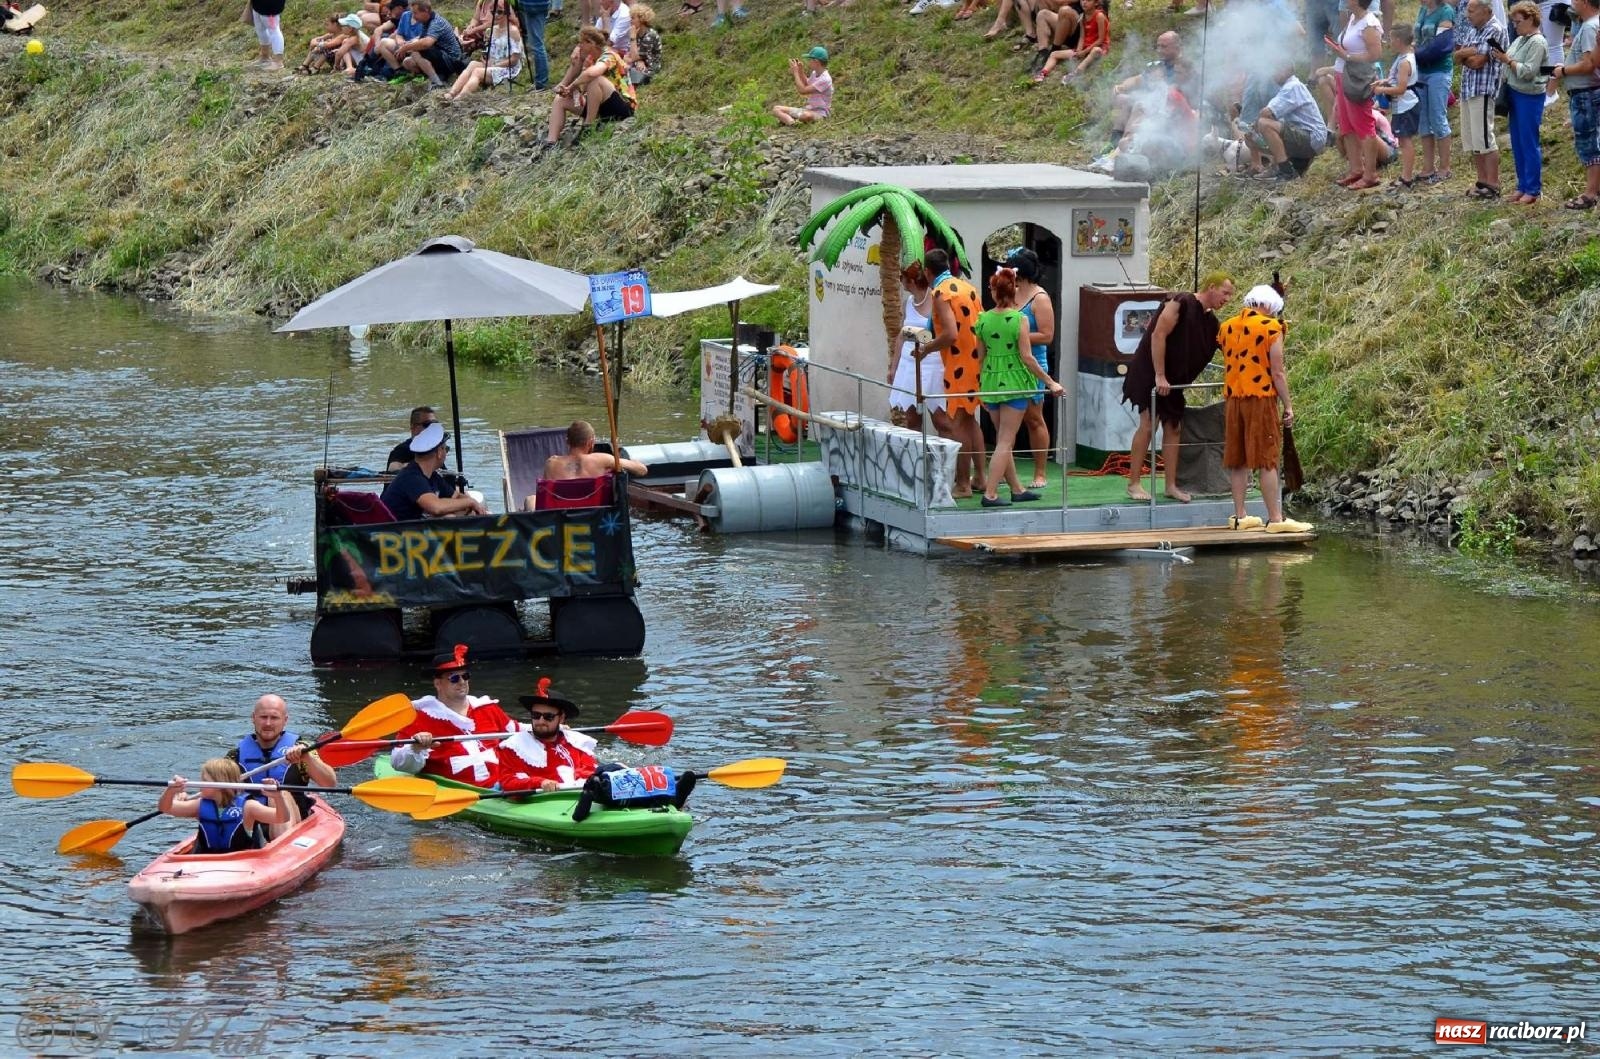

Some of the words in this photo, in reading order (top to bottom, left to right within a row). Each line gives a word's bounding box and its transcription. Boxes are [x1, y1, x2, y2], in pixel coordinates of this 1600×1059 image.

[620, 284, 646, 316] 19
[370, 515, 597, 579] BRZEŹCE
[636, 764, 668, 793] 16
